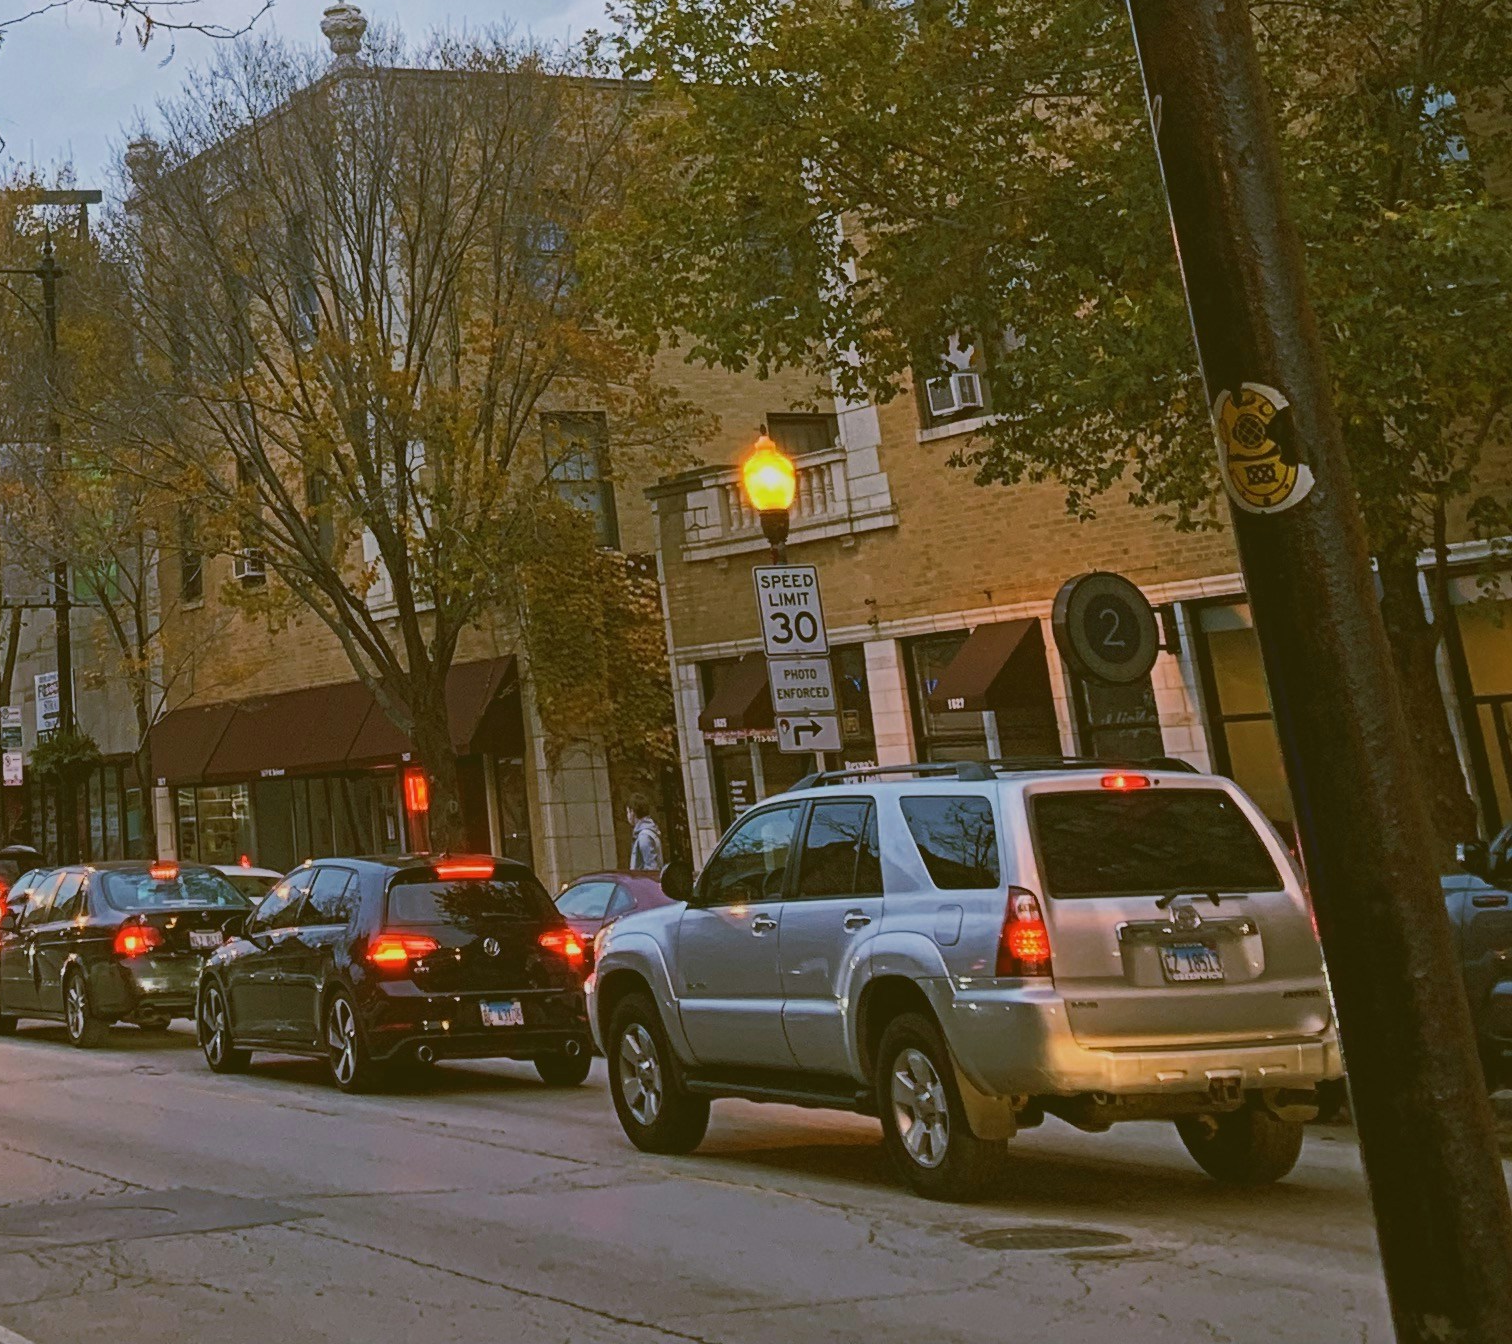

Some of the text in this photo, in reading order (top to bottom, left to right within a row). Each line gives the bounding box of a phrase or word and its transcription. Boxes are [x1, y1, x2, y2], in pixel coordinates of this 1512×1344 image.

[760, 574, 814, 589] SPEED
[768, 592, 810, 607] LIMIT
[770, 611, 818, 645] 30
[1100, 608, 1125, 647] 2
[783, 668, 817, 680] PHOTO
[776, 687, 830, 700] ENFORCED
